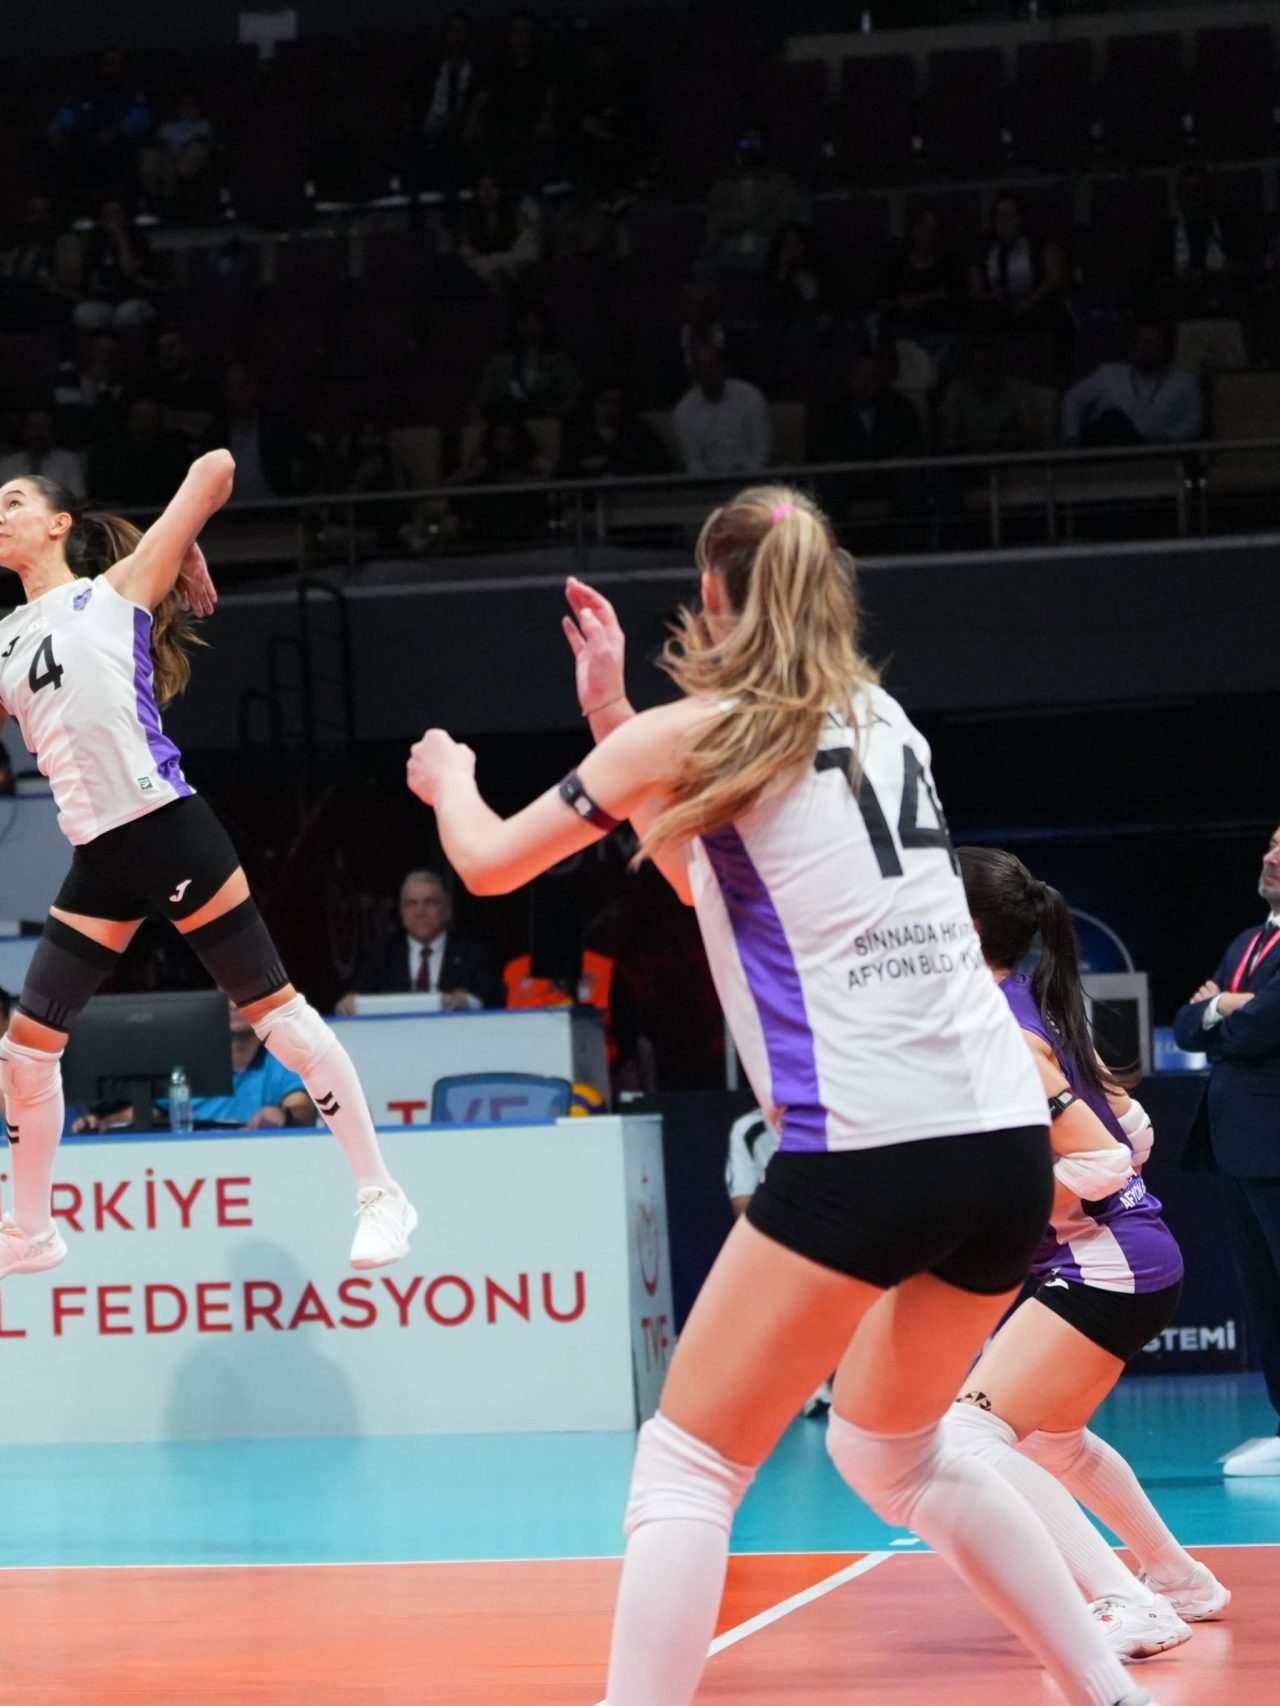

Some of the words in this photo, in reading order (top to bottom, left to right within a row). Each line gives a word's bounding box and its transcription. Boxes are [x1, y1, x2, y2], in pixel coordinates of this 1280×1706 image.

[29, 633, 64, 695] 4
[814, 744, 961, 879] 14
[848, 956, 916, 991] AFYON
[52, 1271, 586, 1336] FEDERASYONU
